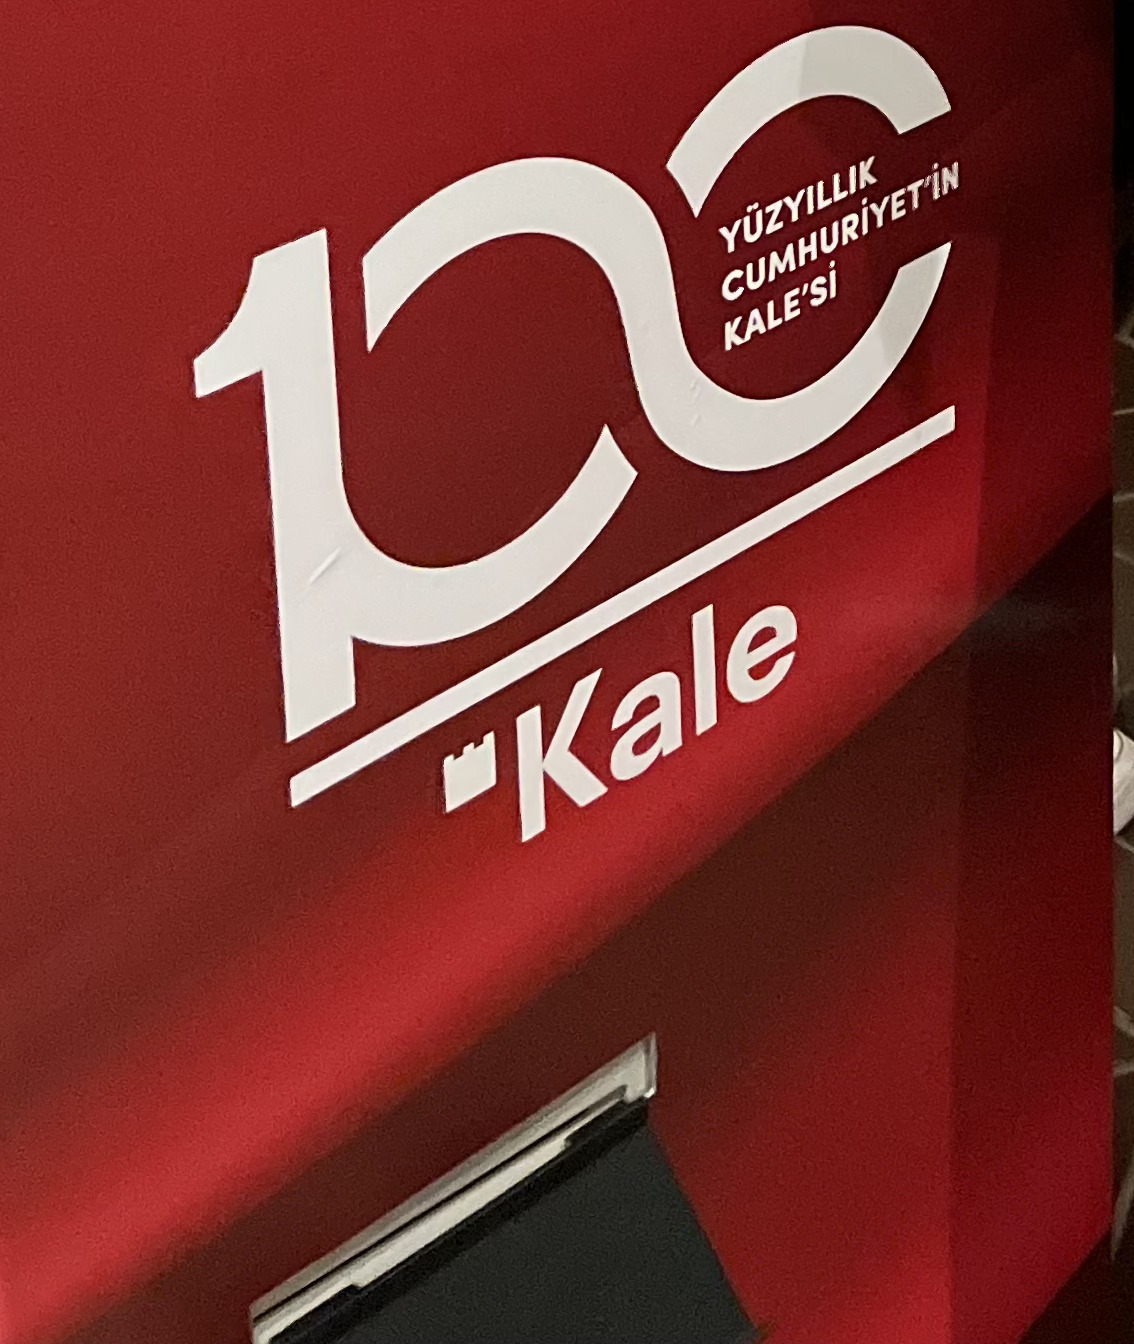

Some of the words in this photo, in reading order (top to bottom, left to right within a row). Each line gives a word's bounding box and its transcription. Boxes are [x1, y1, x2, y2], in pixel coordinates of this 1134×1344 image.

[718, 155, 878, 254] YÜZYILLIK
[193, 25, 952, 743] 100
[516, 603, 798, 843] Kale
